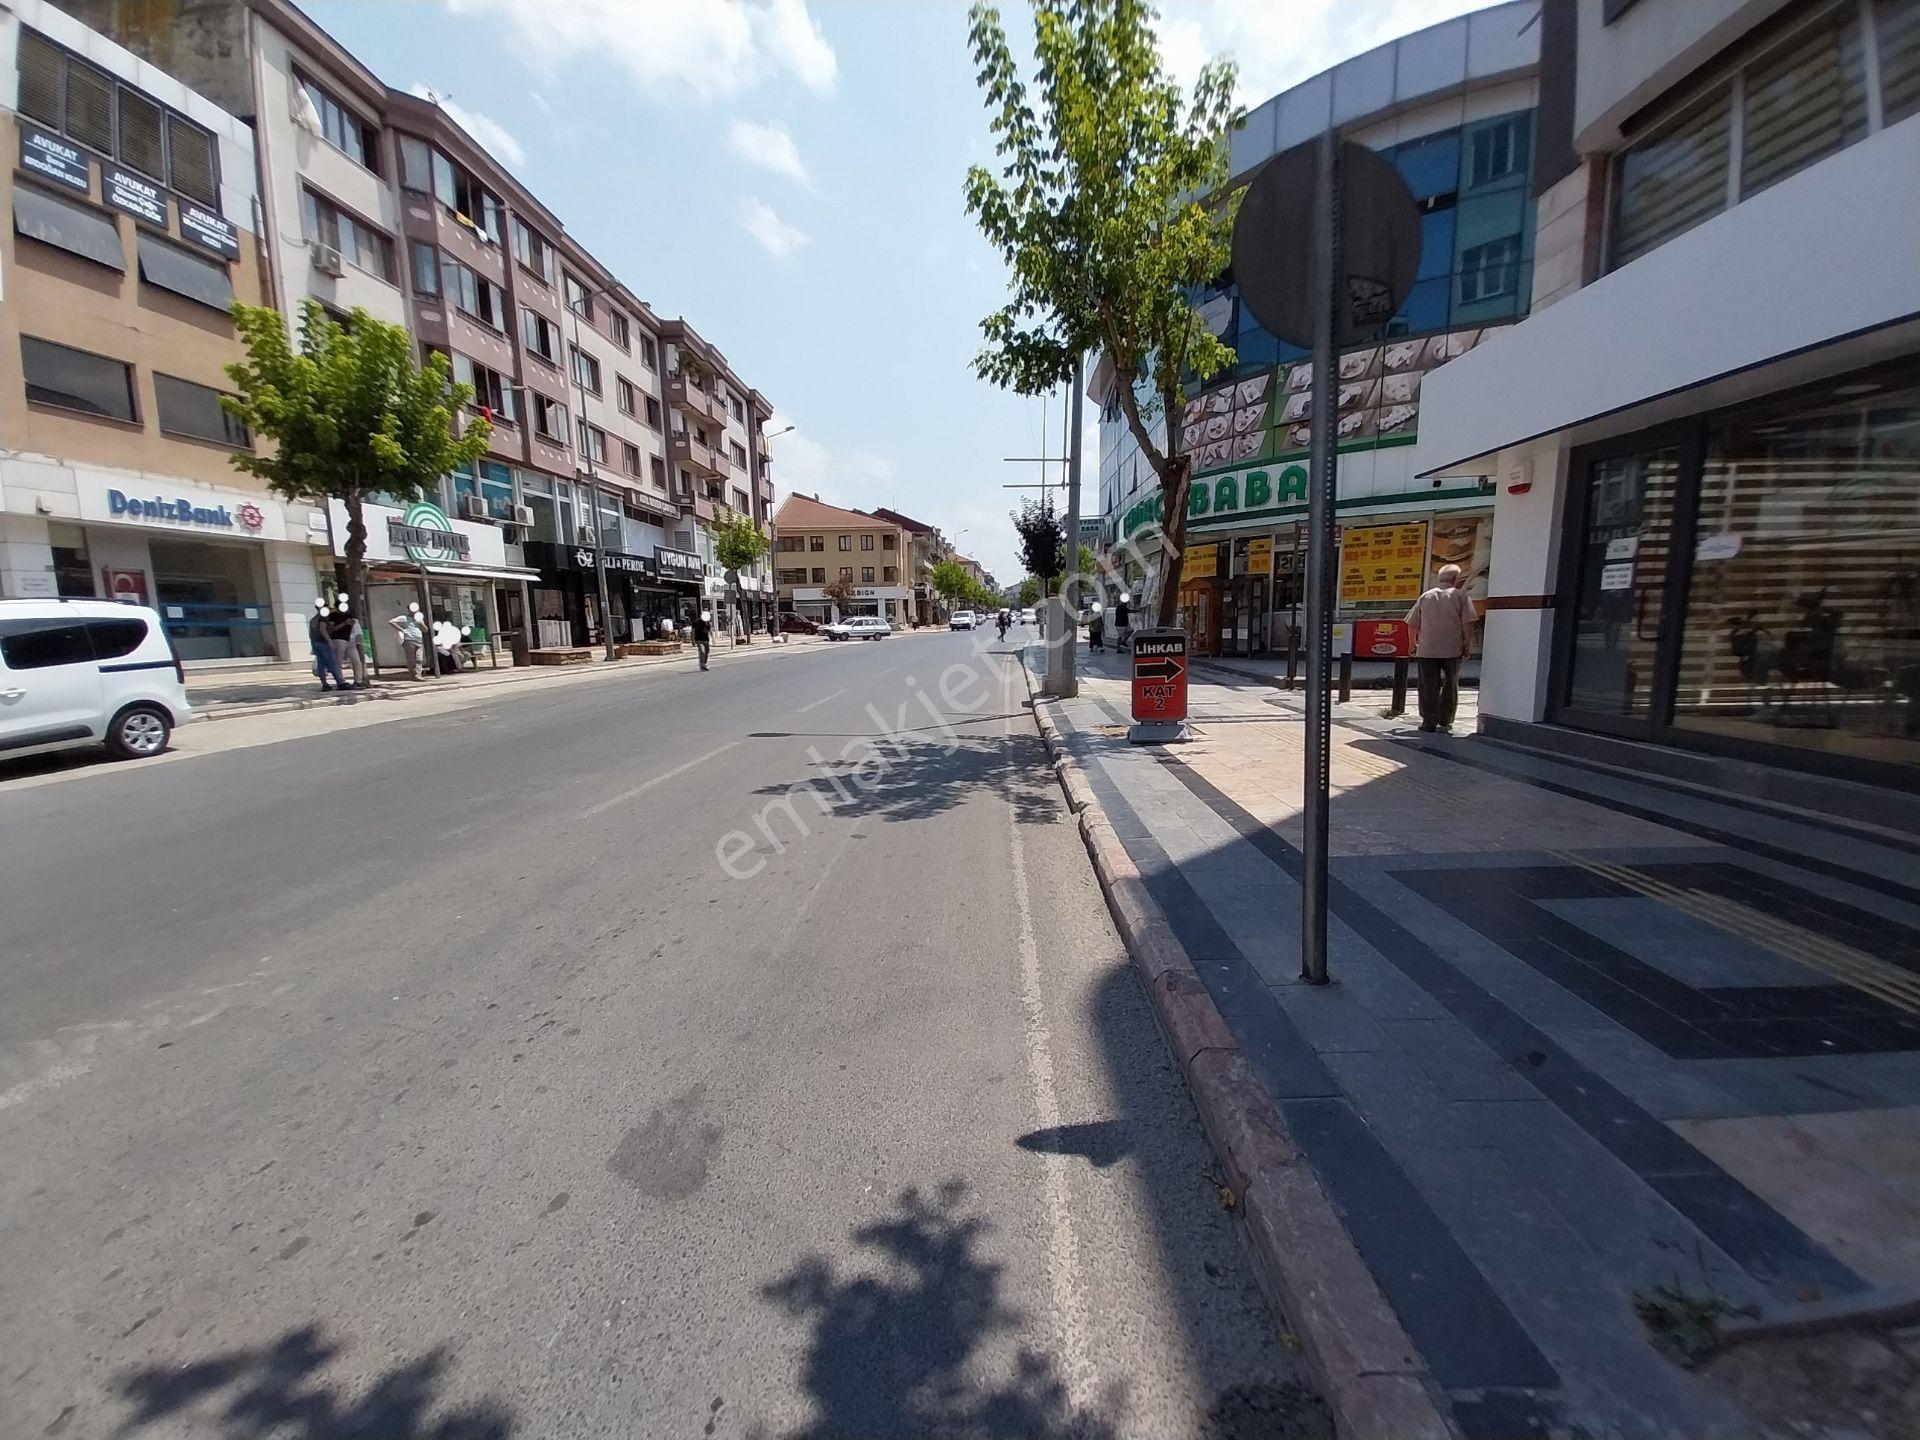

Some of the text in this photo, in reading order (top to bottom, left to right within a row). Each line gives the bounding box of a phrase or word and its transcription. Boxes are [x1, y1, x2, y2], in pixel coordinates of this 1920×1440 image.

[33, 134, 78, 161] AVUKAT
[114, 172, 157, 199] AVUKAT
[189, 207, 228, 233] AVUKAT
[1189, 465, 1308, 516] BABA
[107, 488, 234, 527] DenizBank
[622, 558, 645, 572] PERDE
[660, 550, 686, 568] UYGUN
[1136, 643, 1183, 654] LİHKAB
[1142, 685, 1176, 698] KAT
[1153, 699, 1165, 711] 2
